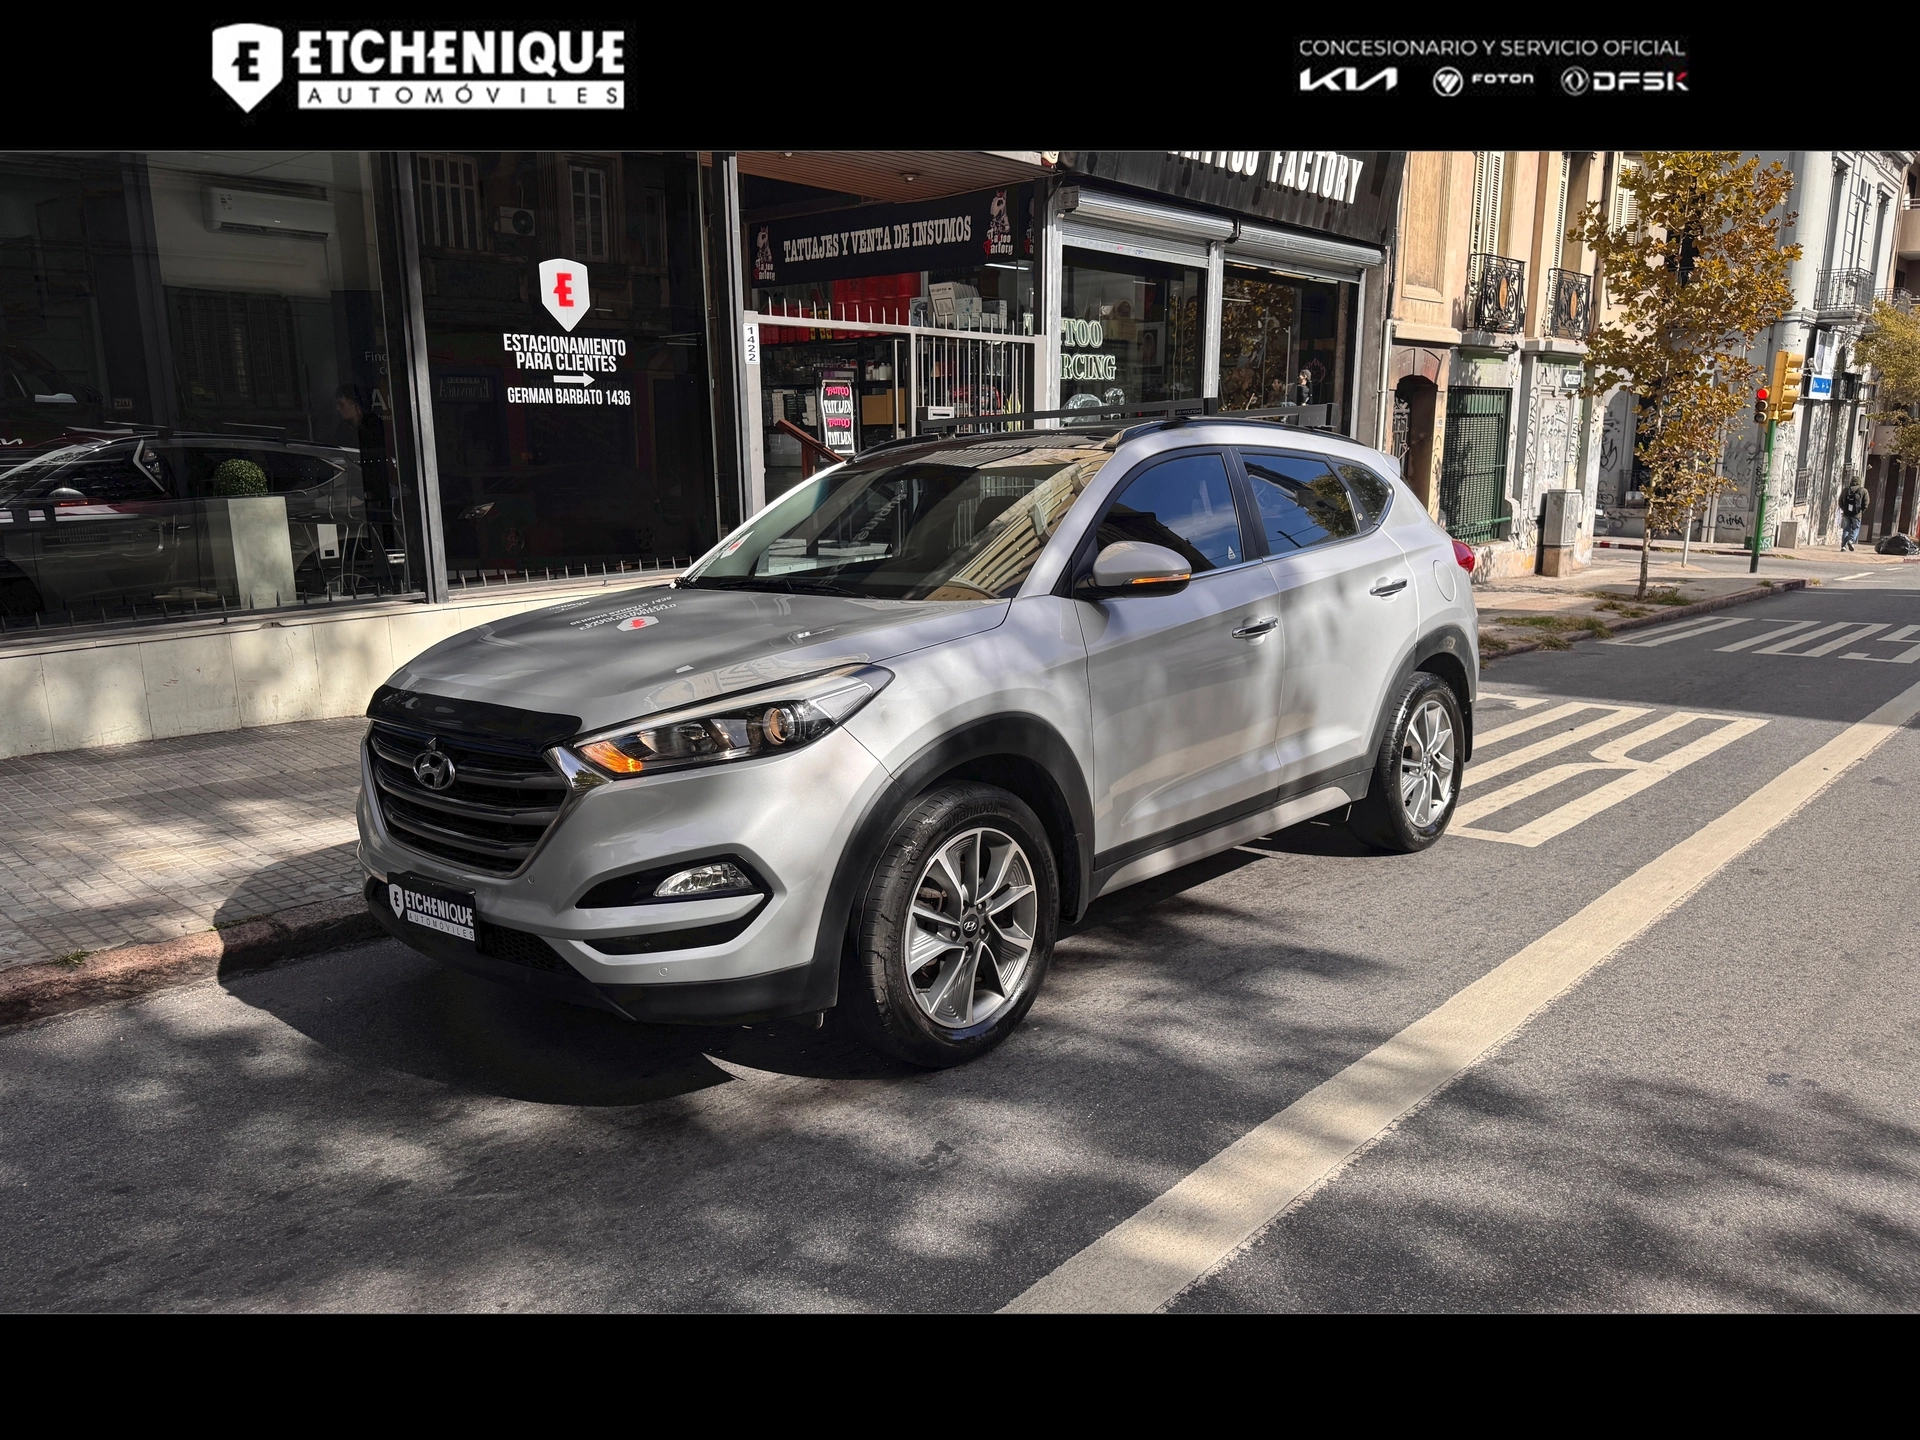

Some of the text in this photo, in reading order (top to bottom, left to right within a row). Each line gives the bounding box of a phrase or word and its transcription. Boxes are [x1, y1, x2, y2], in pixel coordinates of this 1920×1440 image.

[1267, 151, 1364, 204] FACTORY
[784, 215, 972, 263] TATUAJES Y VENTA DE INSUMOS
[503, 333, 626, 356] ESTACIONAMIENTO
[747, 326, 757, 361] 1422
[1060, 317, 1103, 348] TOO
[516, 352, 617, 372] PARA CLIENTES
[1059, 353, 1117, 381] RCING
[507, 387, 631, 406] GERMAN BARBATO 1436
[404, 890, 474, 927] ETCHENIQUE
